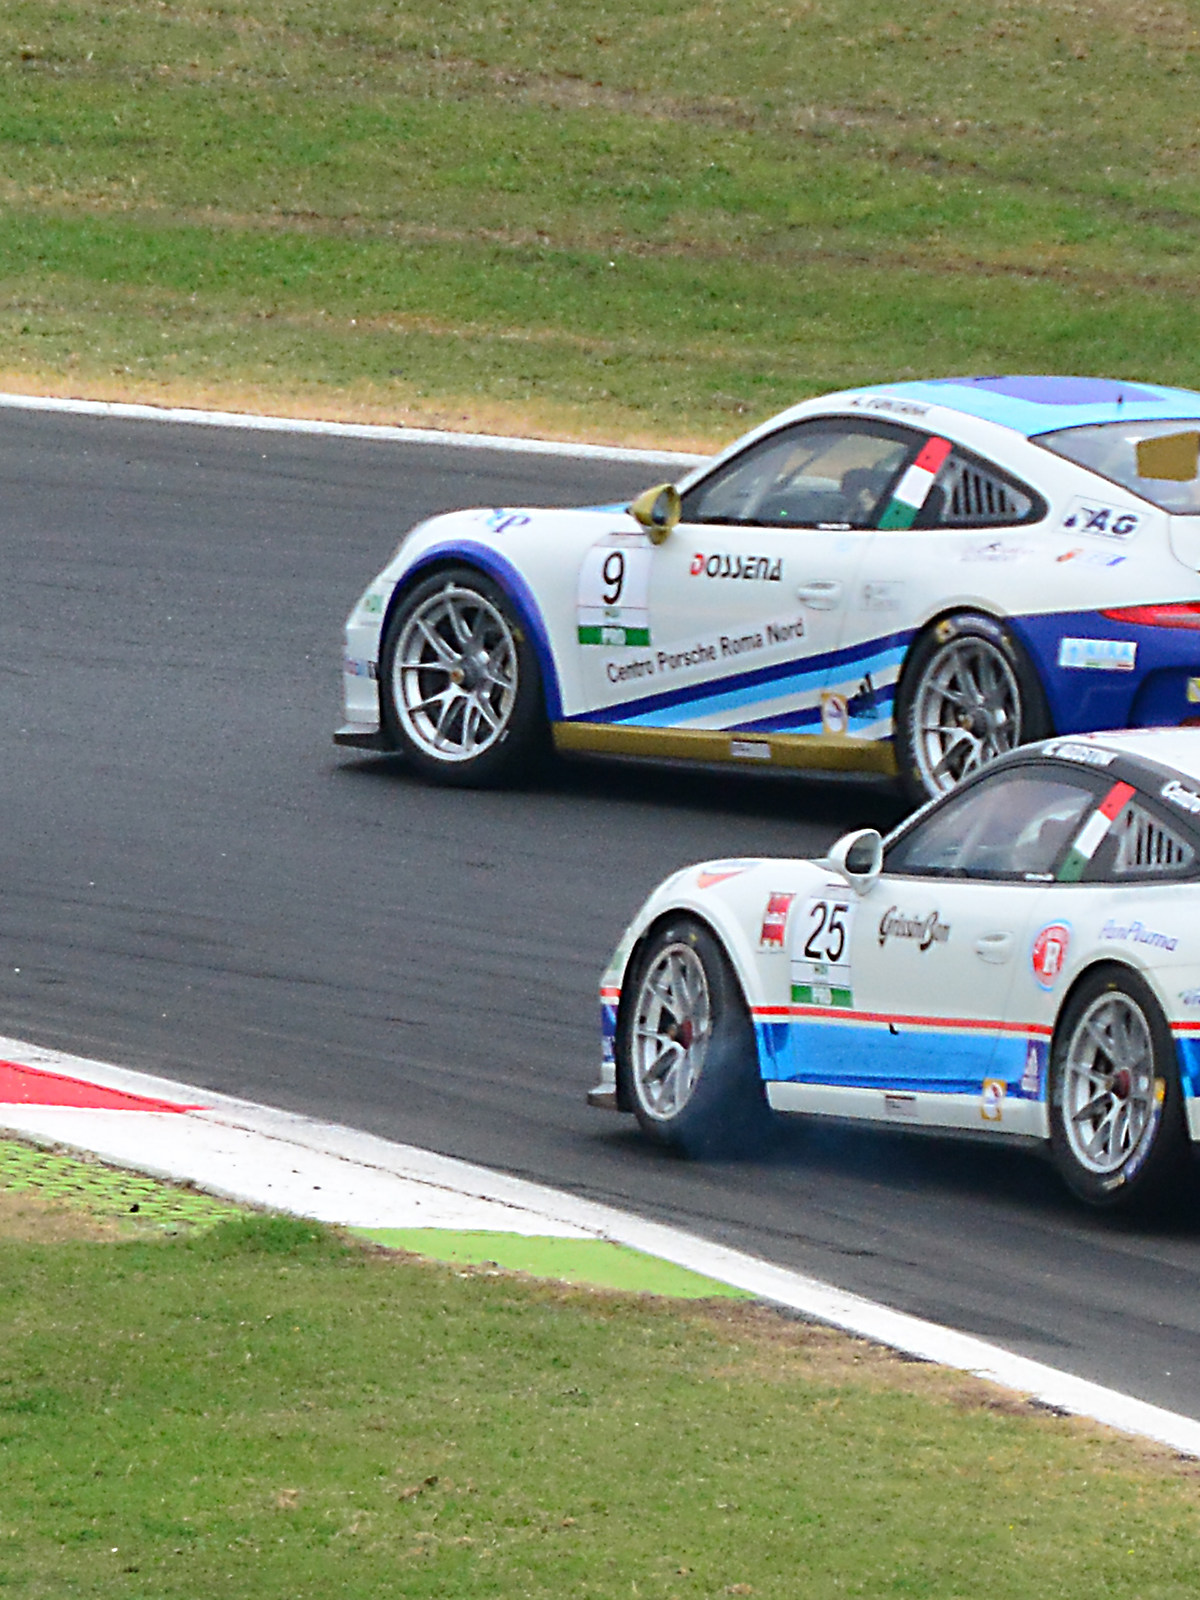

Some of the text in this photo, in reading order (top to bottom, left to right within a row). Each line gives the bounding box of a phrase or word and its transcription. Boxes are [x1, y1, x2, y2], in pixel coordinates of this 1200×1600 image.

[602, 551, 625, 604] 9
[607, 618, 805, 683] Centro Porsche Roma Nord
[804, 901, 848, 962] 25
